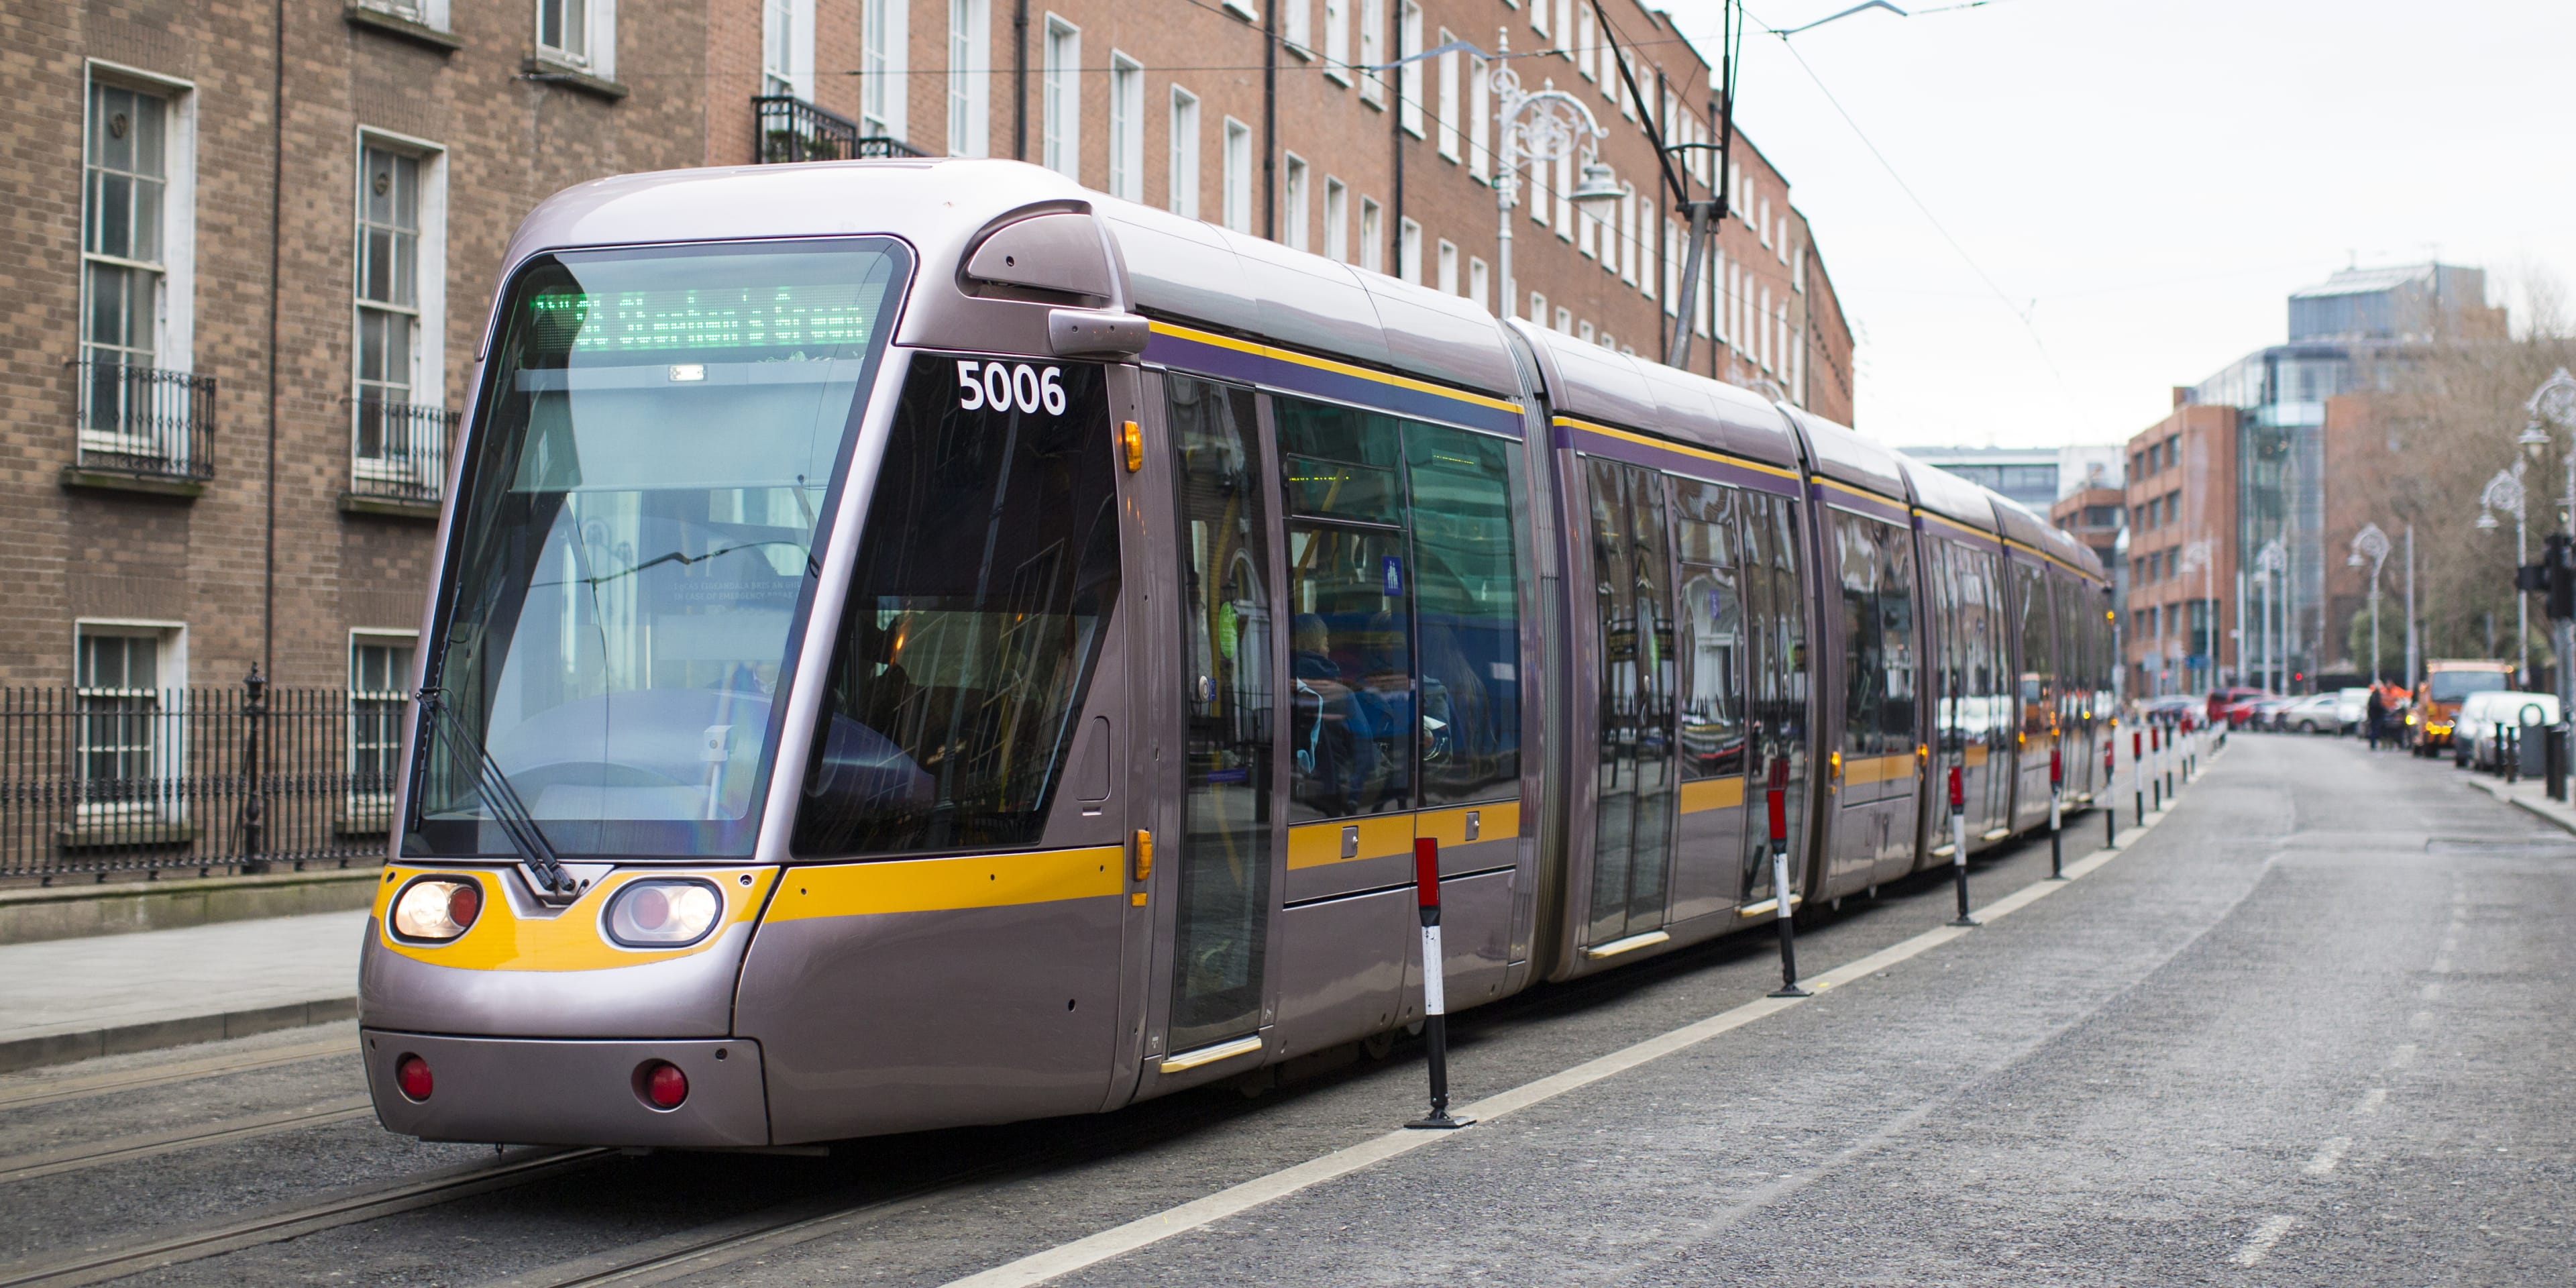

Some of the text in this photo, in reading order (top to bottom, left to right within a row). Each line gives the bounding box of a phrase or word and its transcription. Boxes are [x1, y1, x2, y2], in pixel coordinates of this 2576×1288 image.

[576, 293, 863, 345] St Stephen's Green
[957, 360, 1066, 416] 5006
[686, 592, 704, 600] CASE
[706, 592, 716, 600] OF
[718, 592, 765, 600] EMERGENCY
